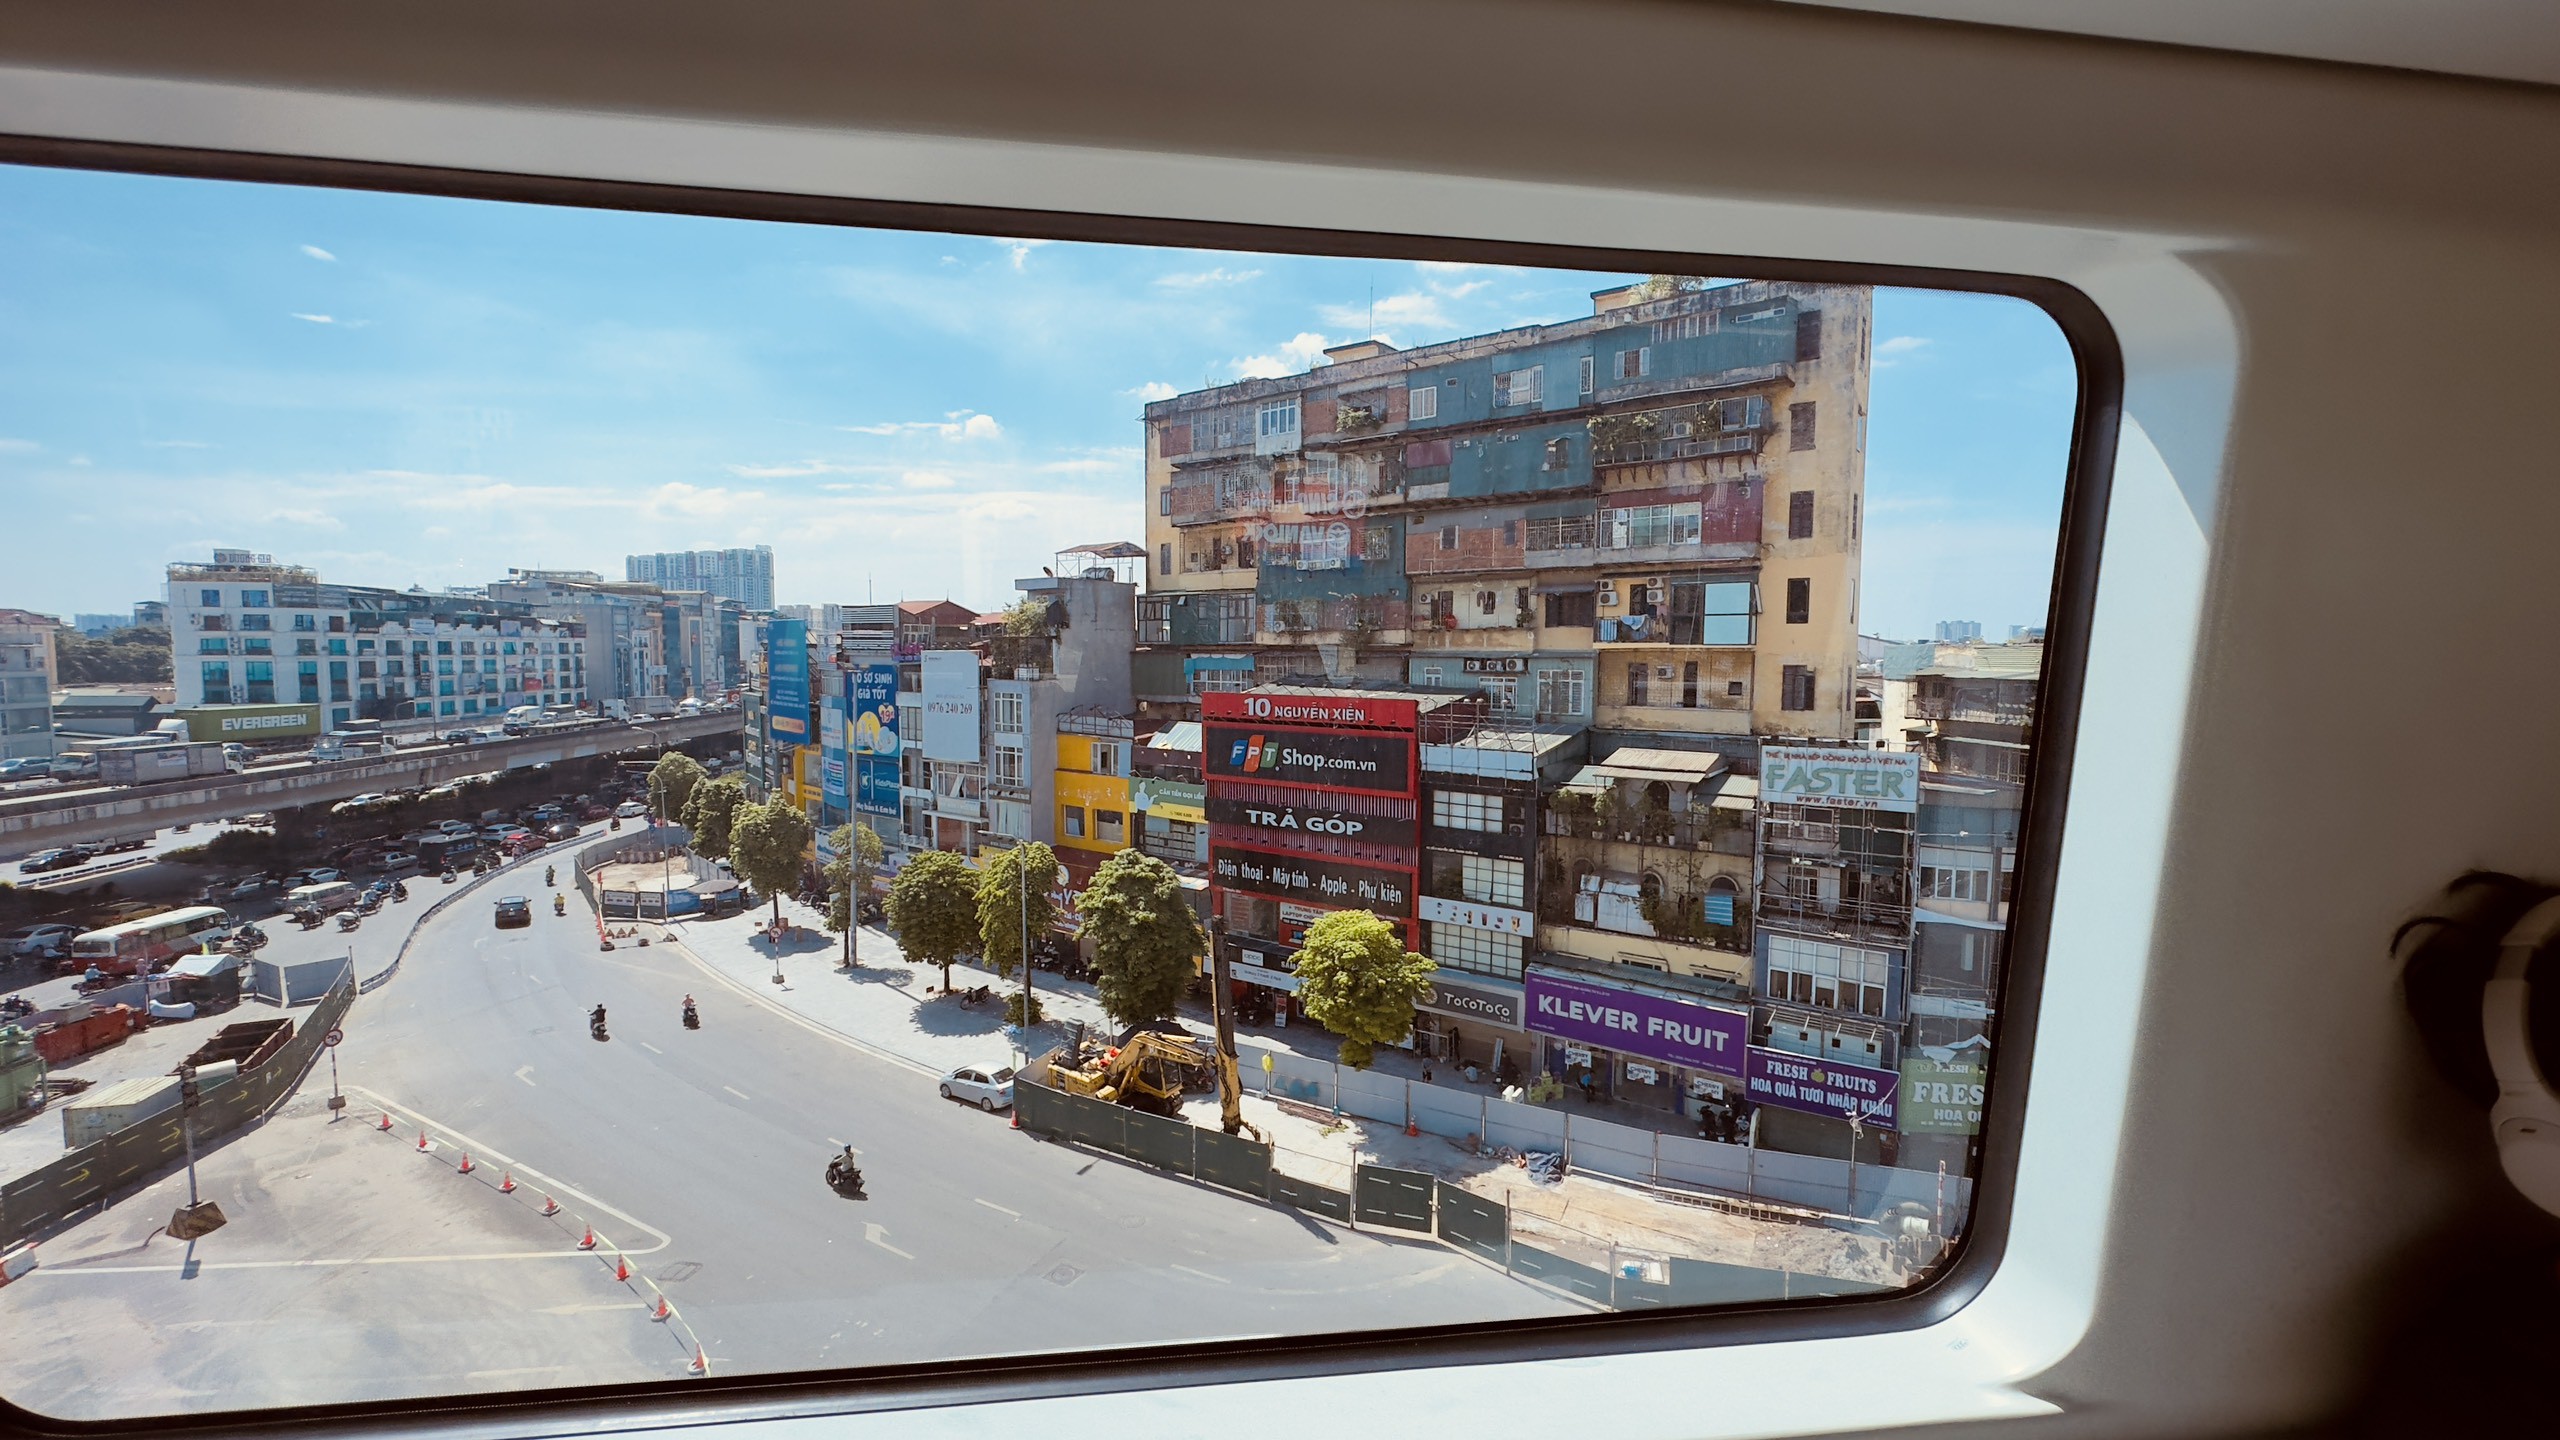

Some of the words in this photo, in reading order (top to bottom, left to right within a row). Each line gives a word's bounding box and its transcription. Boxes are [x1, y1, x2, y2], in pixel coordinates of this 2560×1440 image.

[871, 684, 888, 700] TỐT
[876, 673, 893, 686] SINH
[927, 702, 944, 713] 0976
[945, 703, 959, 714] 240
[960, 703, 973, 714] 269
[1244, 697, 1271, 718] 10
[1274, 702, 1328, 720] NGUYỄN
[221, 714, 307, 731] EVERGREEN
[1230, 742, 1277, 764] FPT
[1282, 747, 1377, 772] Shop.com.vn
[1765, 764, 1904, 798] FASTER
[1796, 795, 1878, 808] www.faster.vn
[1246, 808, 1299, 830] TRẢ
[1305, 814, 1363, 836] GÓP
[1218, 859, 1237, 881] Điện
[1241, 861, 1264, 885] thoại
[1273, 867, 1291, 890] Máy
[1291, 869, 1309, 889] tính
[1320, 874, 1348, 898] Apple
[1358, 879, 1378, 904] Phụ
[1380, 883, 1402, 907] kiện
[1538, 993, 1639, 1034] KLEVER
[1648, 1016, 1729, 1052] FRUIT
[1766, 1060, 1808, 1081] FRESH
[1826, 1071, 1877, 1094] FRUITS
[1750, 1077, 1772, 1093] HOA
[1774, 1081, 1797, 1099] QUẢ
[1799, 1086, 1824, 1104] TƯƠI
[1826, 1092, 1858, 1112] NHẬP
[1860, 1097, 1893, 1117] KHẨU
[1933, 1109, 1963, 1121] HOA
